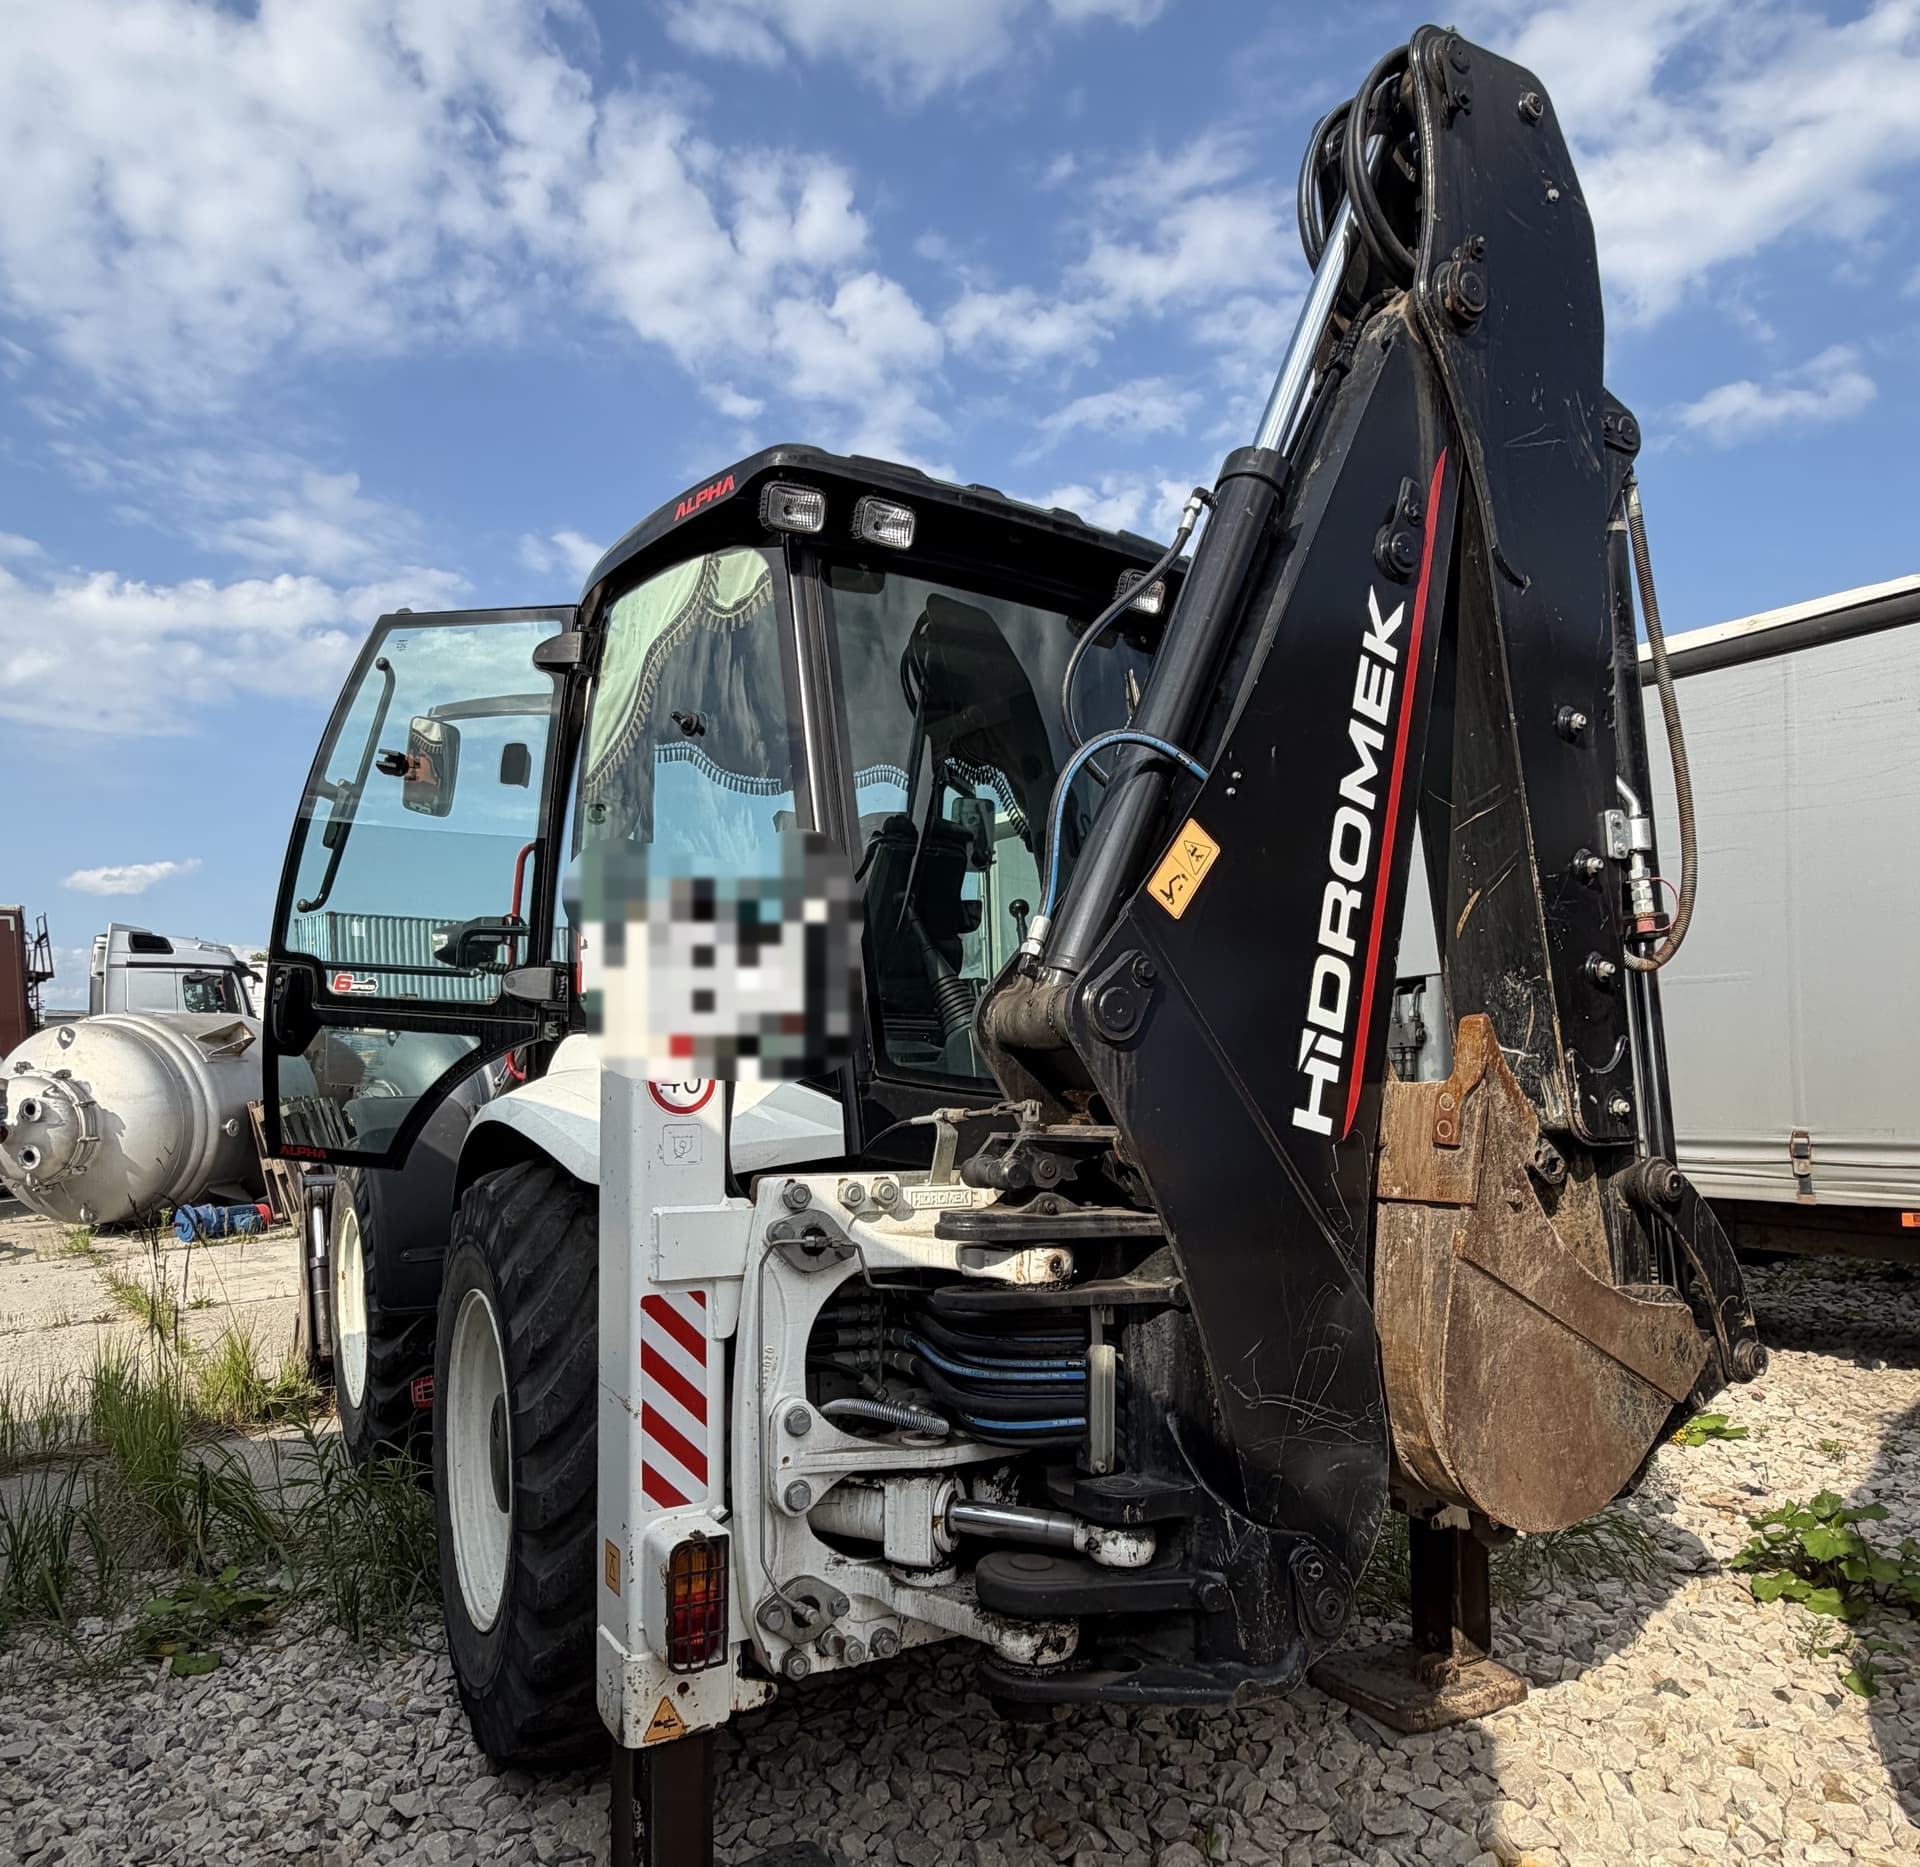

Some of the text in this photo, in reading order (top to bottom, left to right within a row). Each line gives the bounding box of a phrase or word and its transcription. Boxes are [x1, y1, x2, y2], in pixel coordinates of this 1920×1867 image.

[673, 475, 735, 522] ALPHA
[334, 974, 353, 992] 6
[280, 1145, 327, 1159] ALPHA
